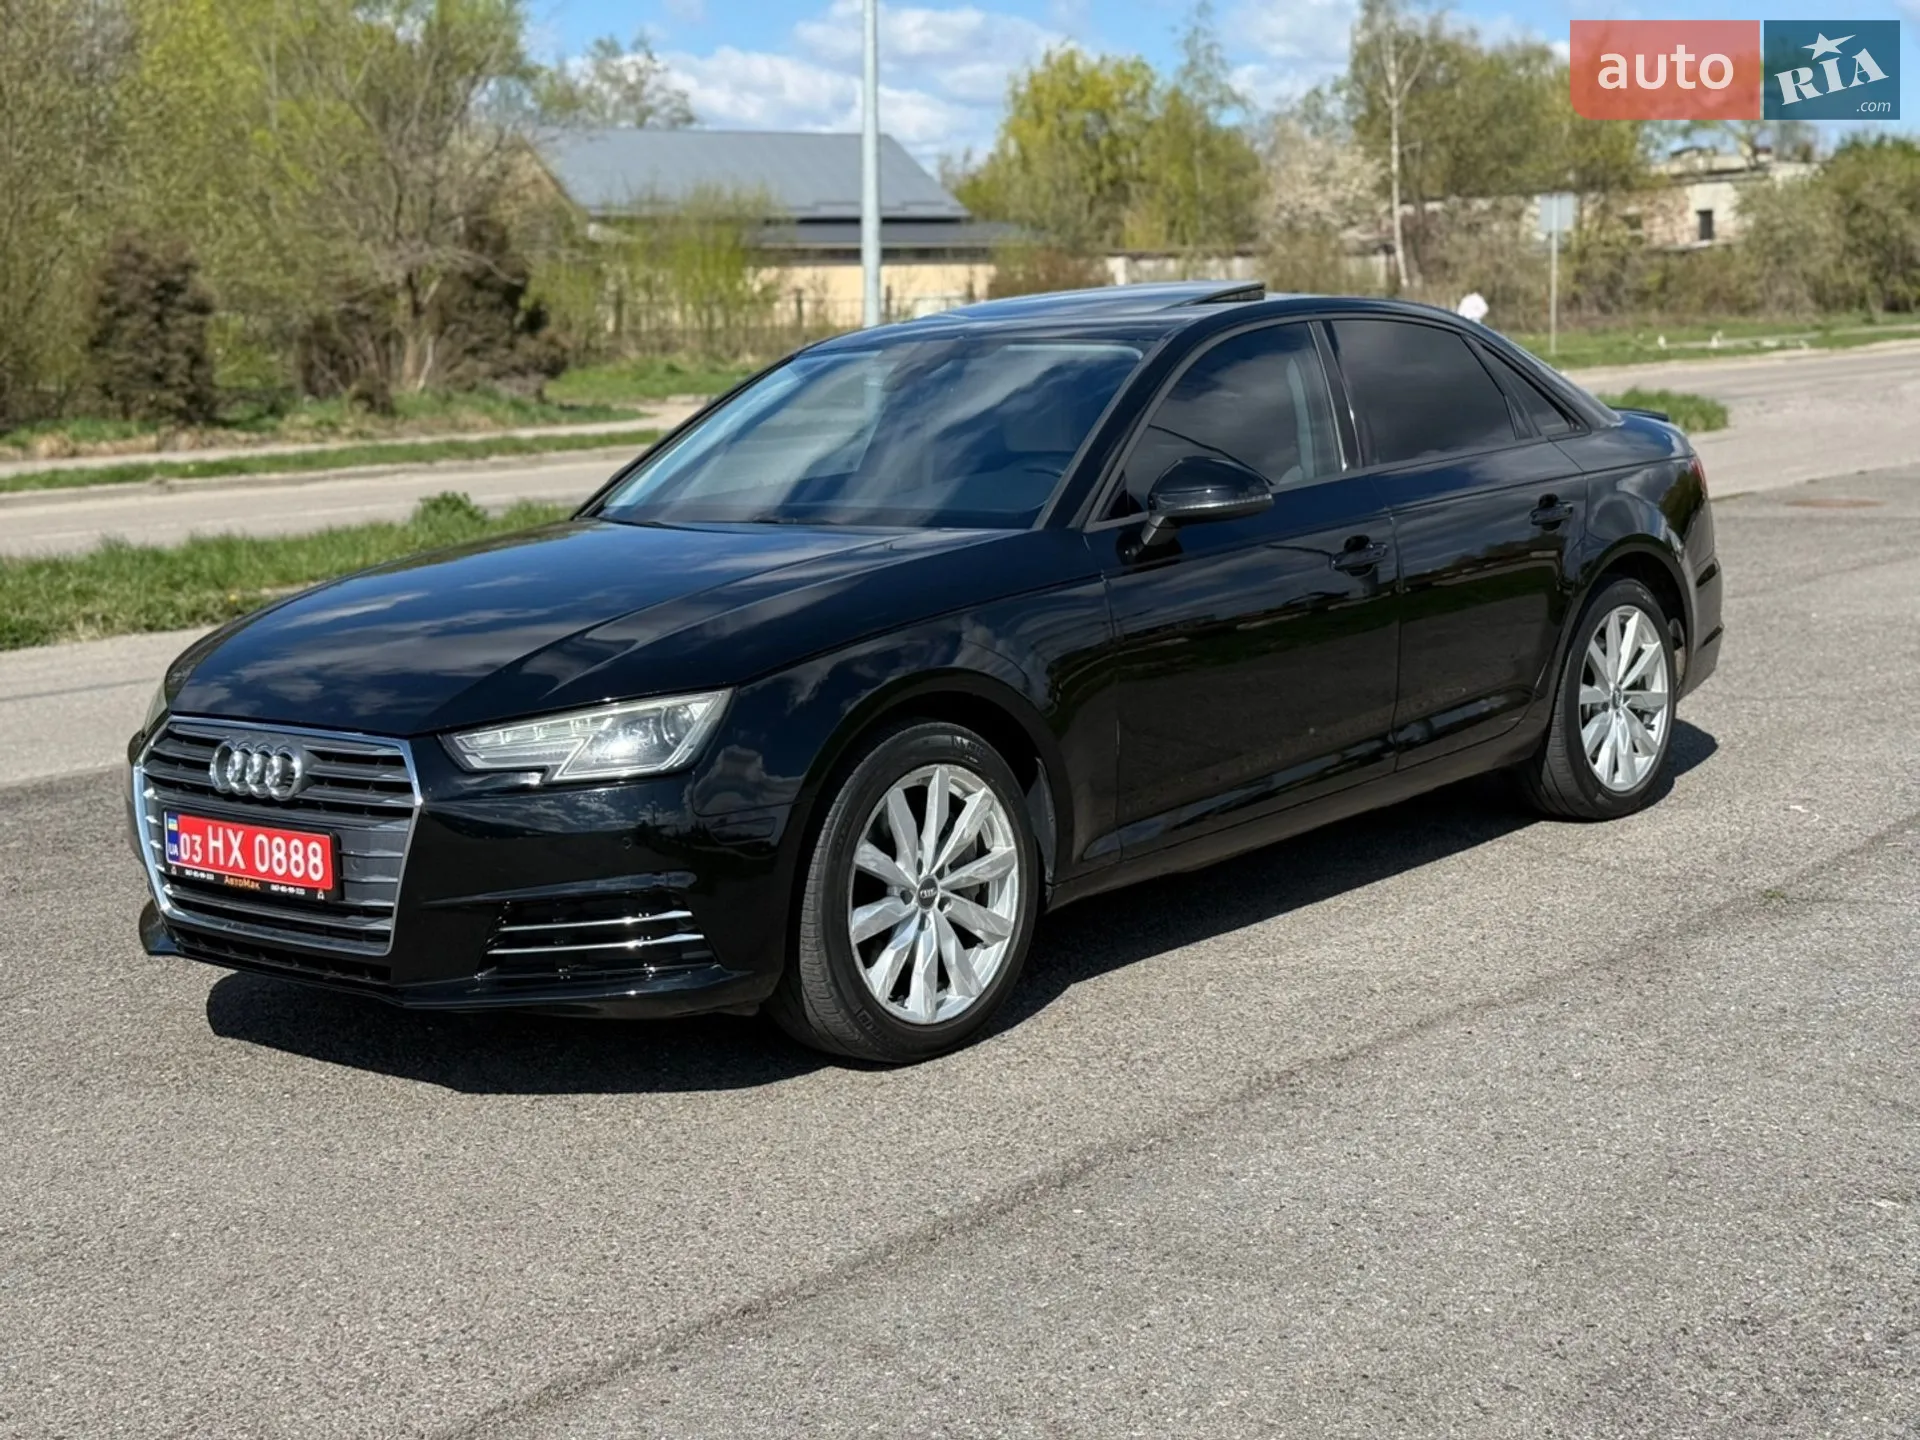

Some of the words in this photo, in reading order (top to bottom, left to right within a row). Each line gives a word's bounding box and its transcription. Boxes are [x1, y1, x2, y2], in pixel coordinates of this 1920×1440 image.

[168, 843, 179, 857] UA
[180, 833, 202, 863] 03
[207, 825, 246, 870] HX
[254, 833, 324, 881] 0888
